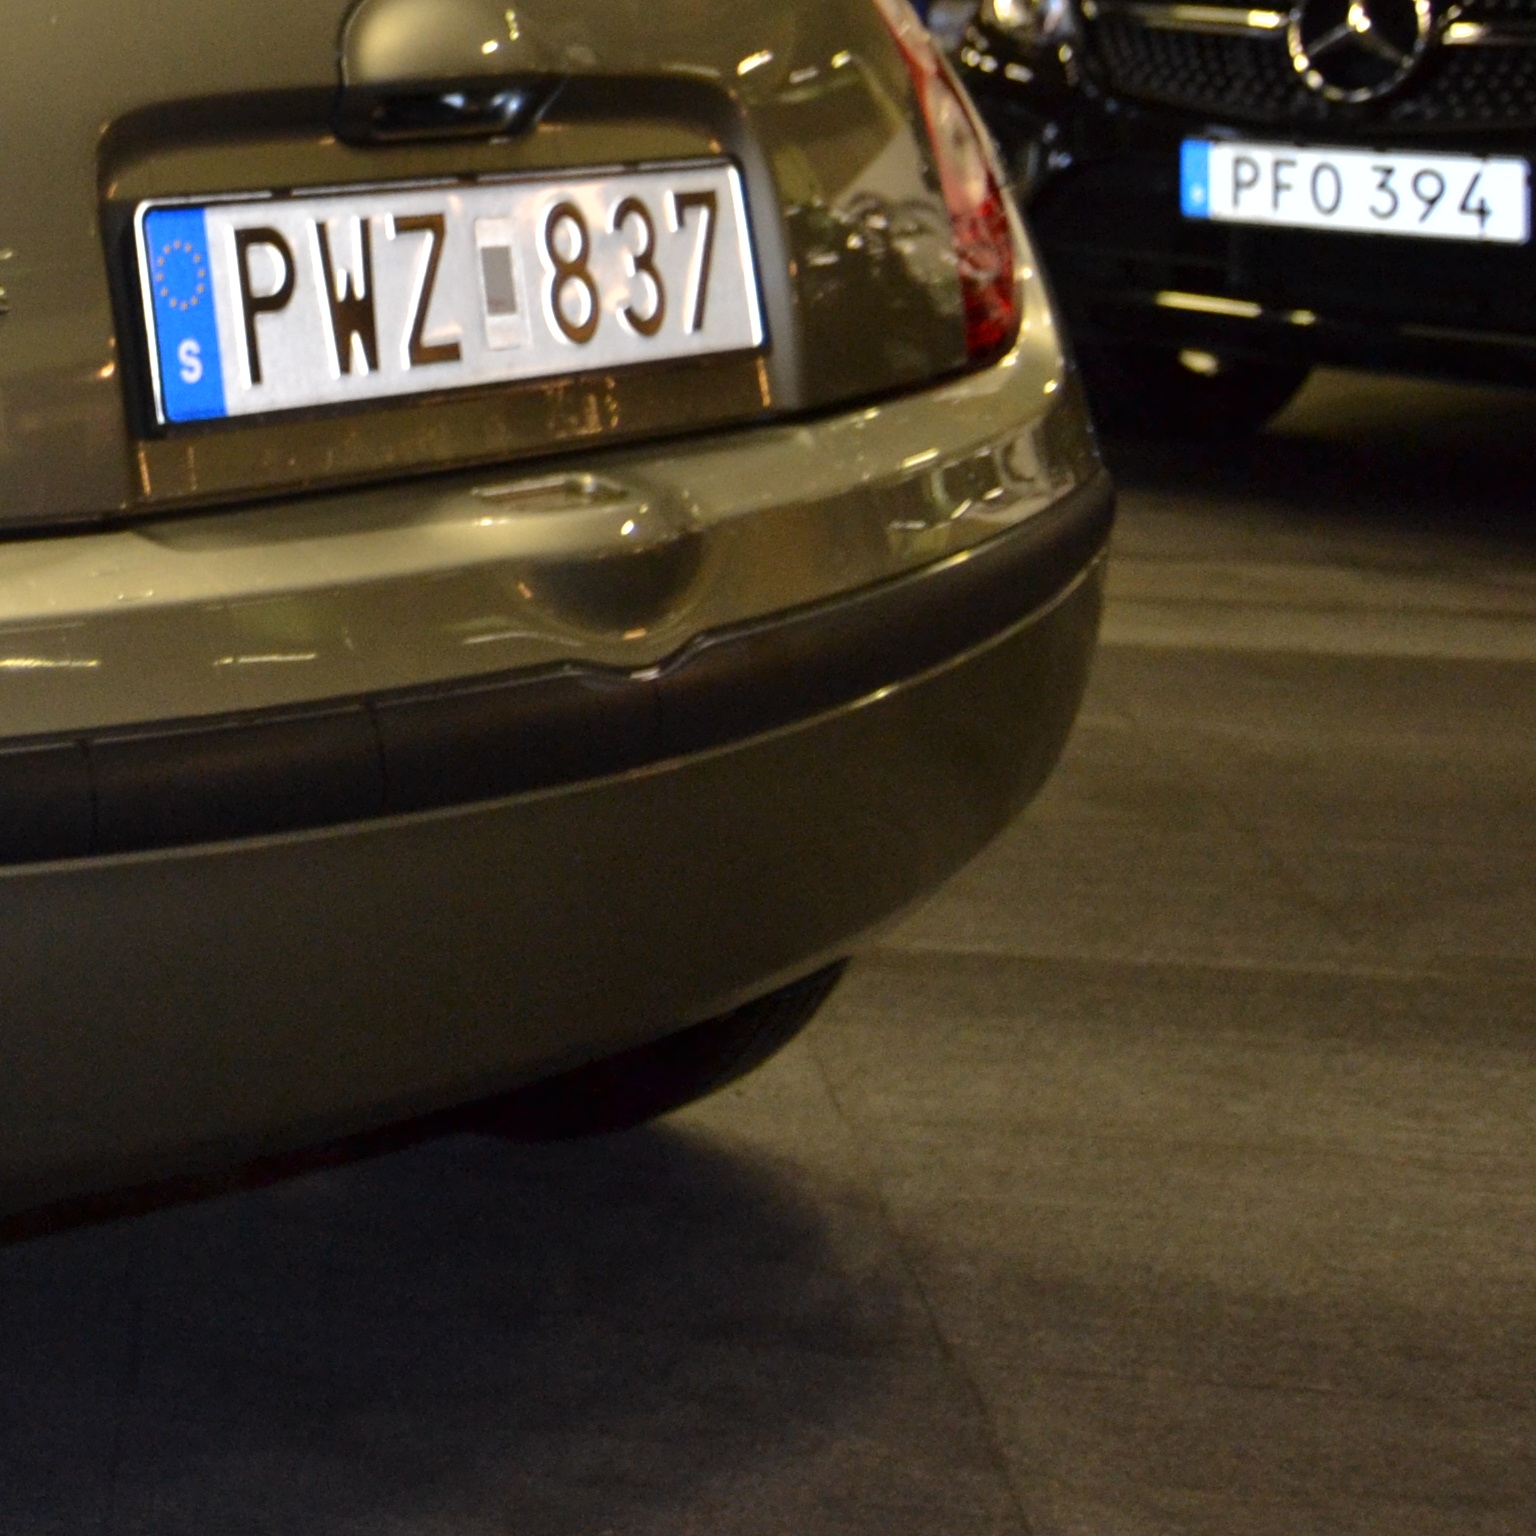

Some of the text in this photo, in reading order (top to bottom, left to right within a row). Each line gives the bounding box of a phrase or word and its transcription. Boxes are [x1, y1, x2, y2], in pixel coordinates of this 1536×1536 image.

[1231, 156, 1493, 228] PFO 394
[226, 190, 717, 390] PWZ 837
[178, 338, 203, 384] S
